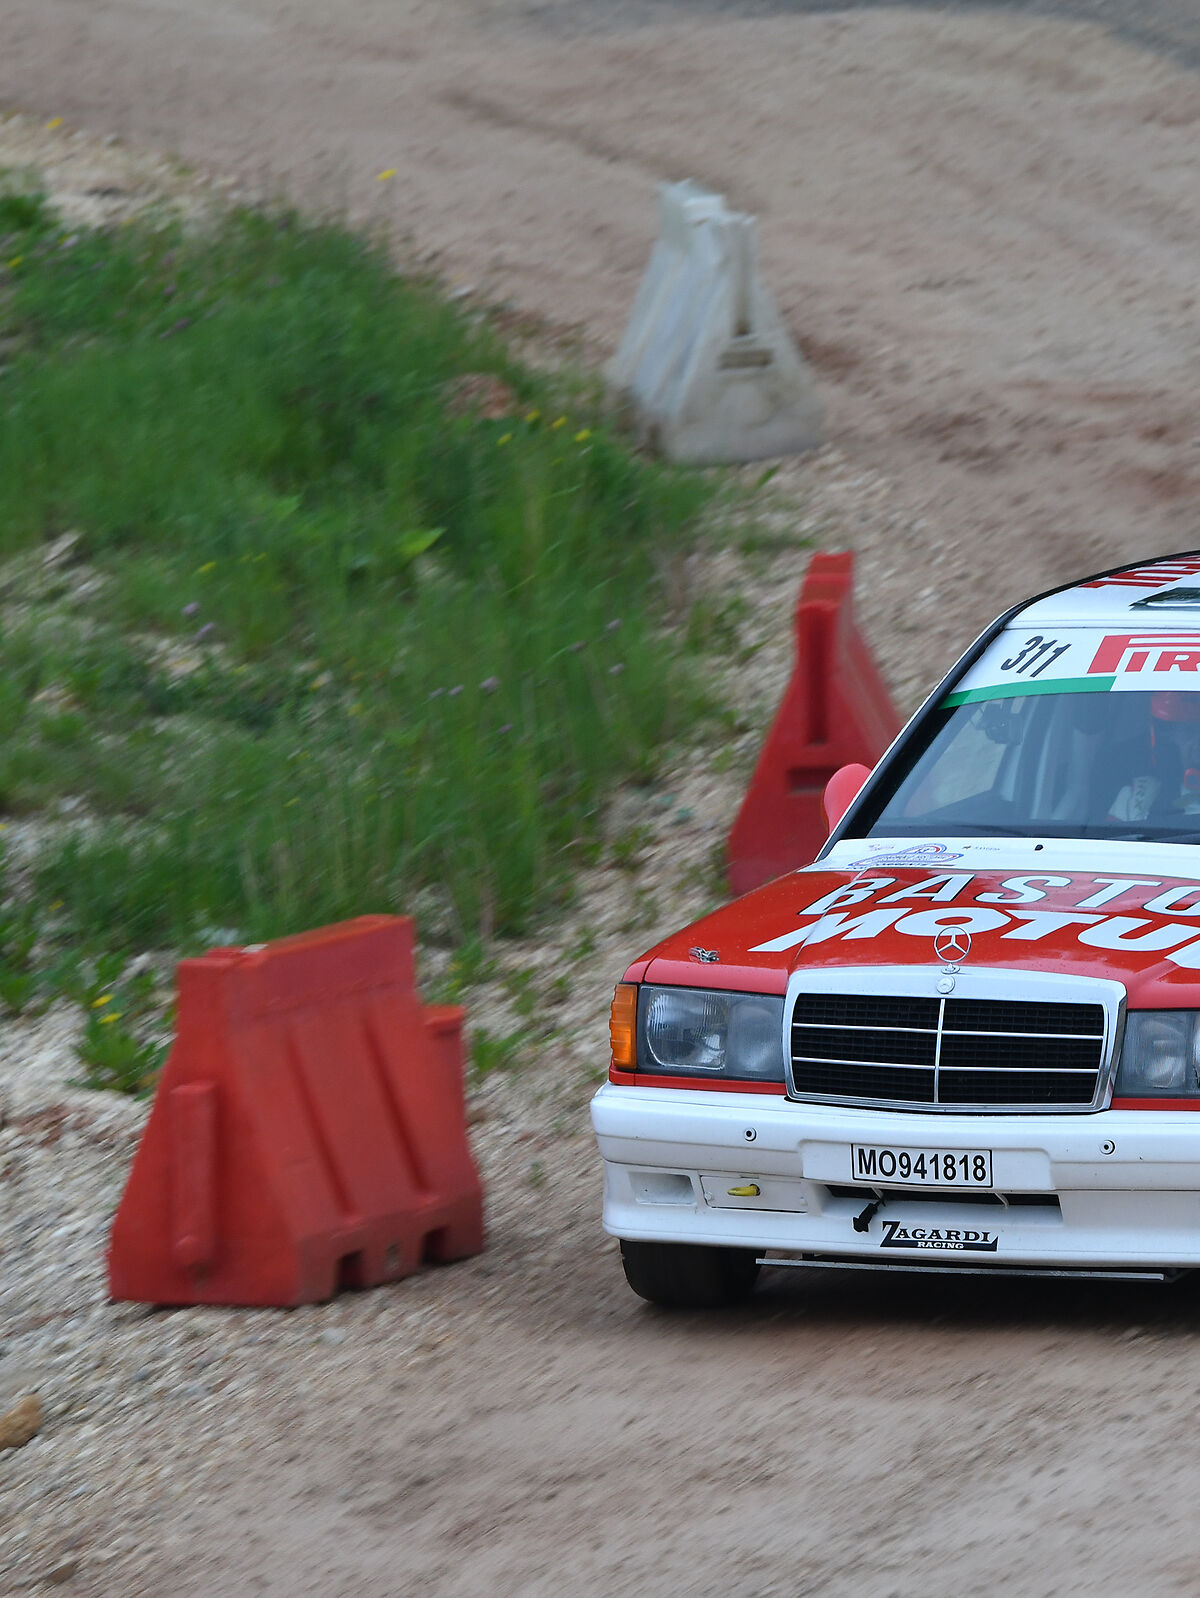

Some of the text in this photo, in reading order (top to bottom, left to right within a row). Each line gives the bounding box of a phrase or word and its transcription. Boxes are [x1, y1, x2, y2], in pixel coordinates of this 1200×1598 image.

[1001, 635, 1071, 677] 311
[857, 1148, 988, 1183] MO941818
[880, 1221, 998, 1251] ZAGARDI
[917, 1241, 964, 1249] RACING
